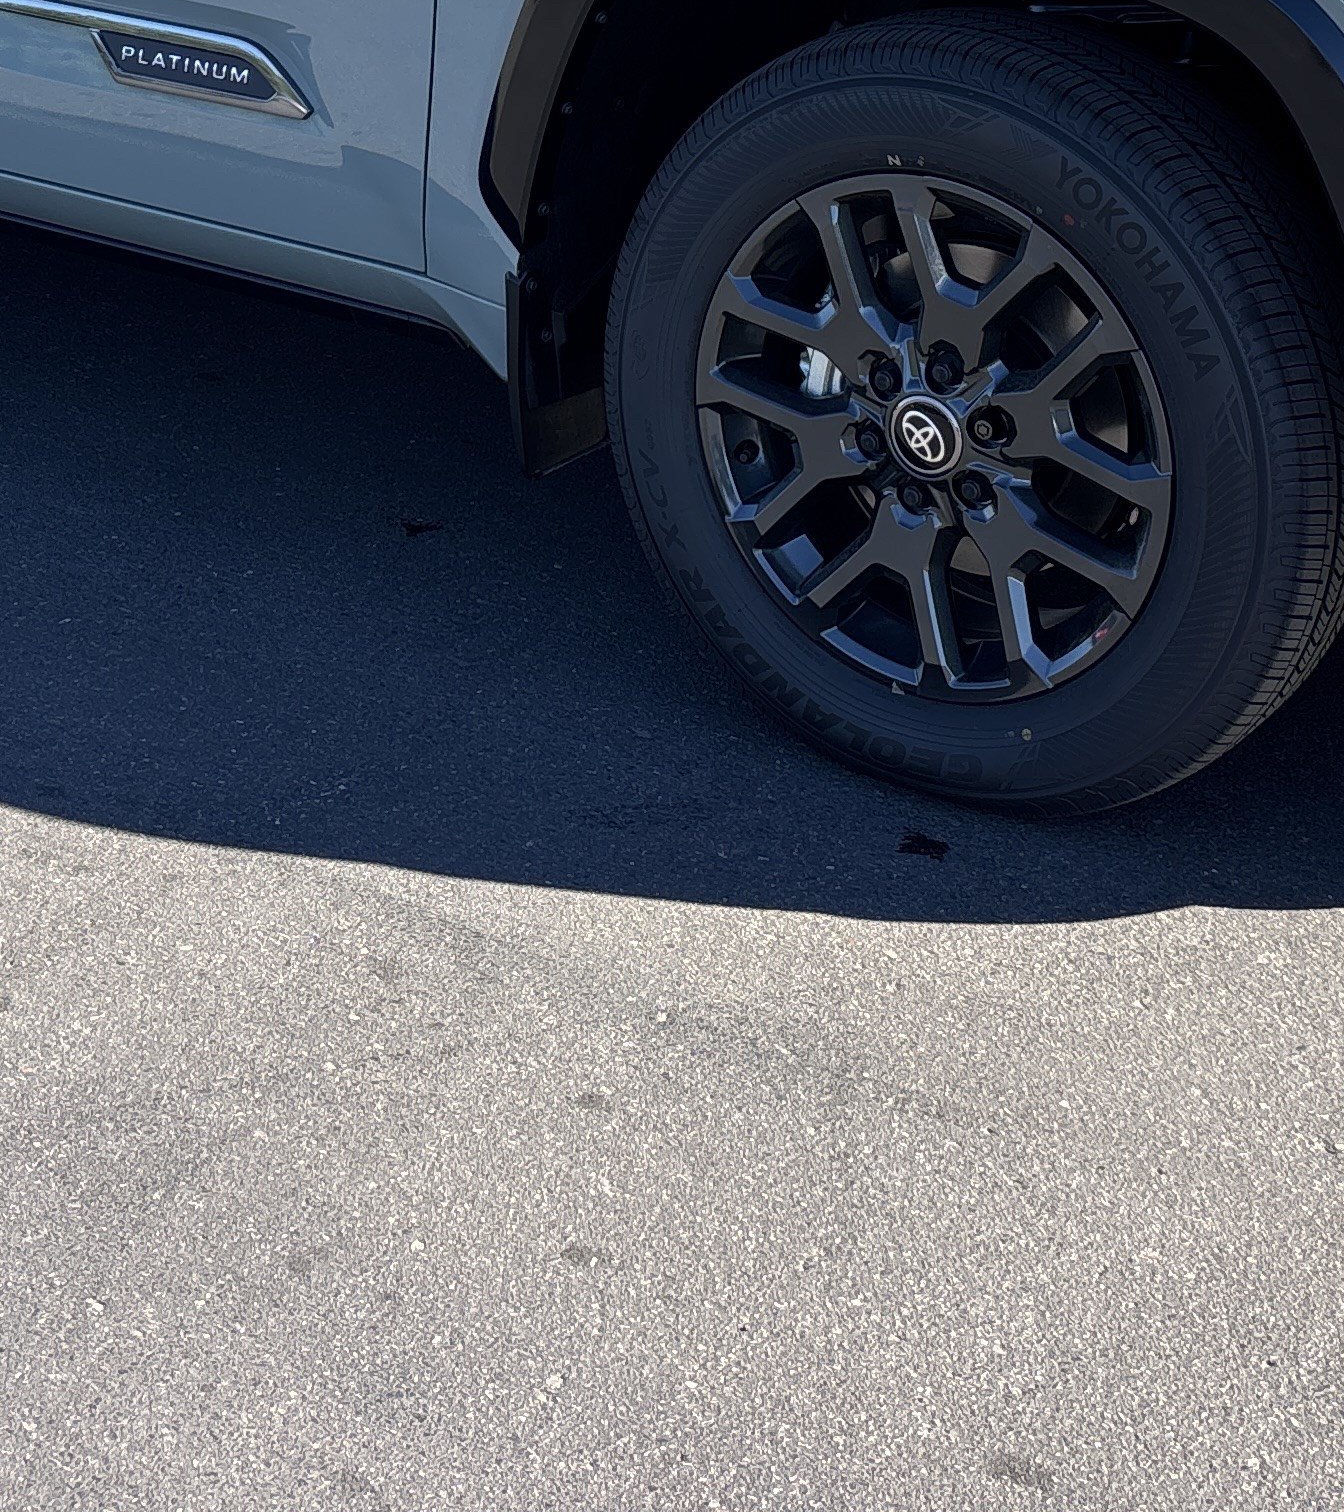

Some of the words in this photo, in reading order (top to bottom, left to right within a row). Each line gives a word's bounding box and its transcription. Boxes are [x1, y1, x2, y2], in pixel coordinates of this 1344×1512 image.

[121, 45, 250, 84] PLATINUM
[1055, 154, 1222, 383] YOKOHAMA
[677, 567, 984, 779] GEOLANDAR
